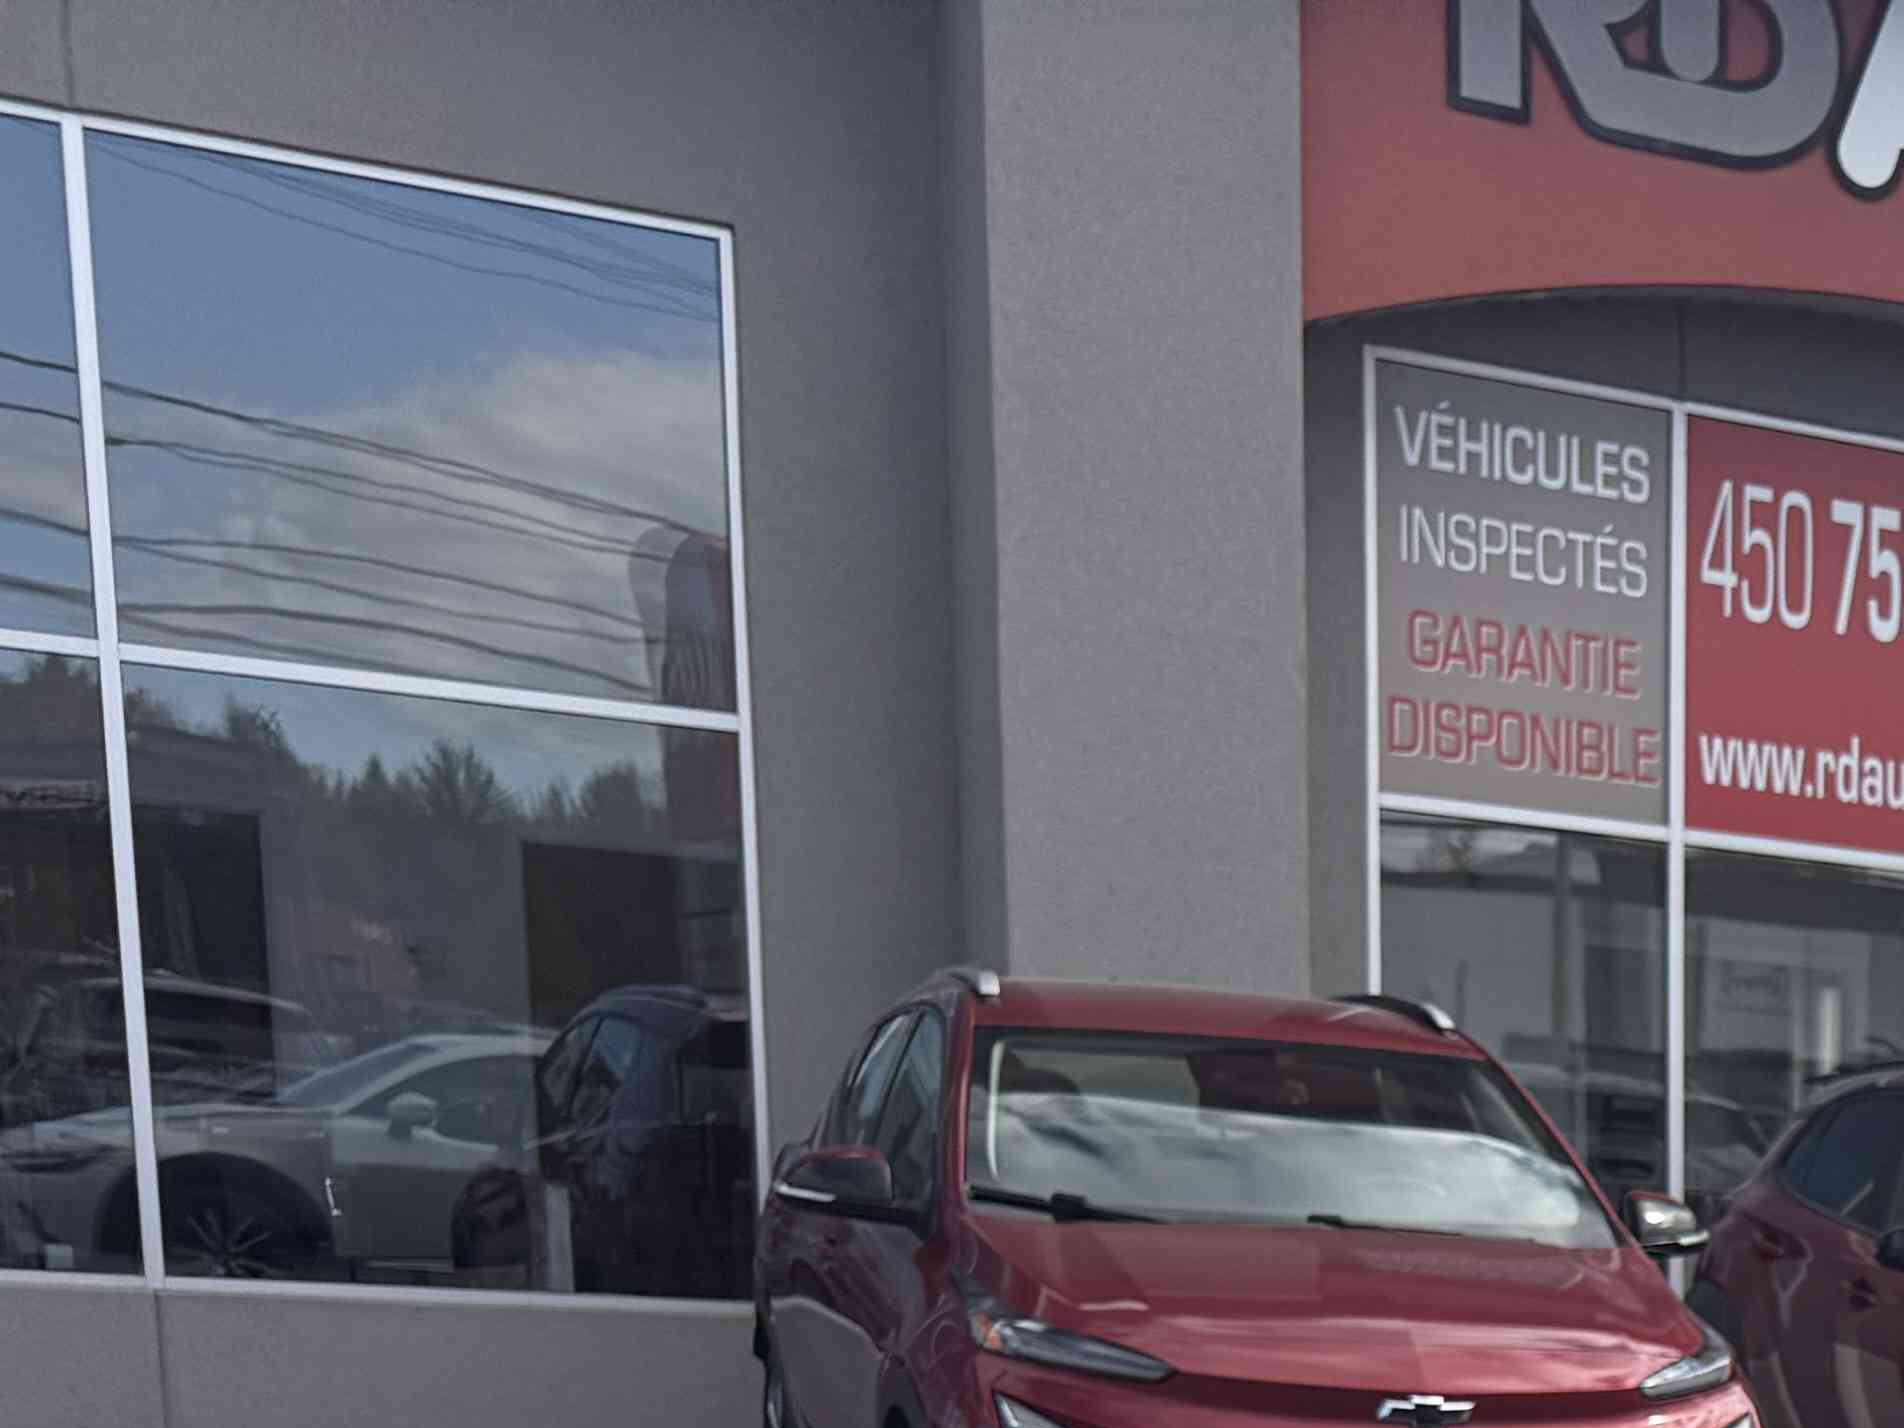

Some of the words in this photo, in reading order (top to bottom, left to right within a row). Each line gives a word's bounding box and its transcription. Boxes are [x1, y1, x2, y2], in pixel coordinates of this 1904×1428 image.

[1394, 401, 1650, 503] VÉHICULES
[1400, 506, 1648, 598] INSPECTÉS
[1700, 480, 1814, 629] 450
[1408, 609, 1642, 700] GARANTIE
[1387, 695, 1663, 787] DISPONIBLE
